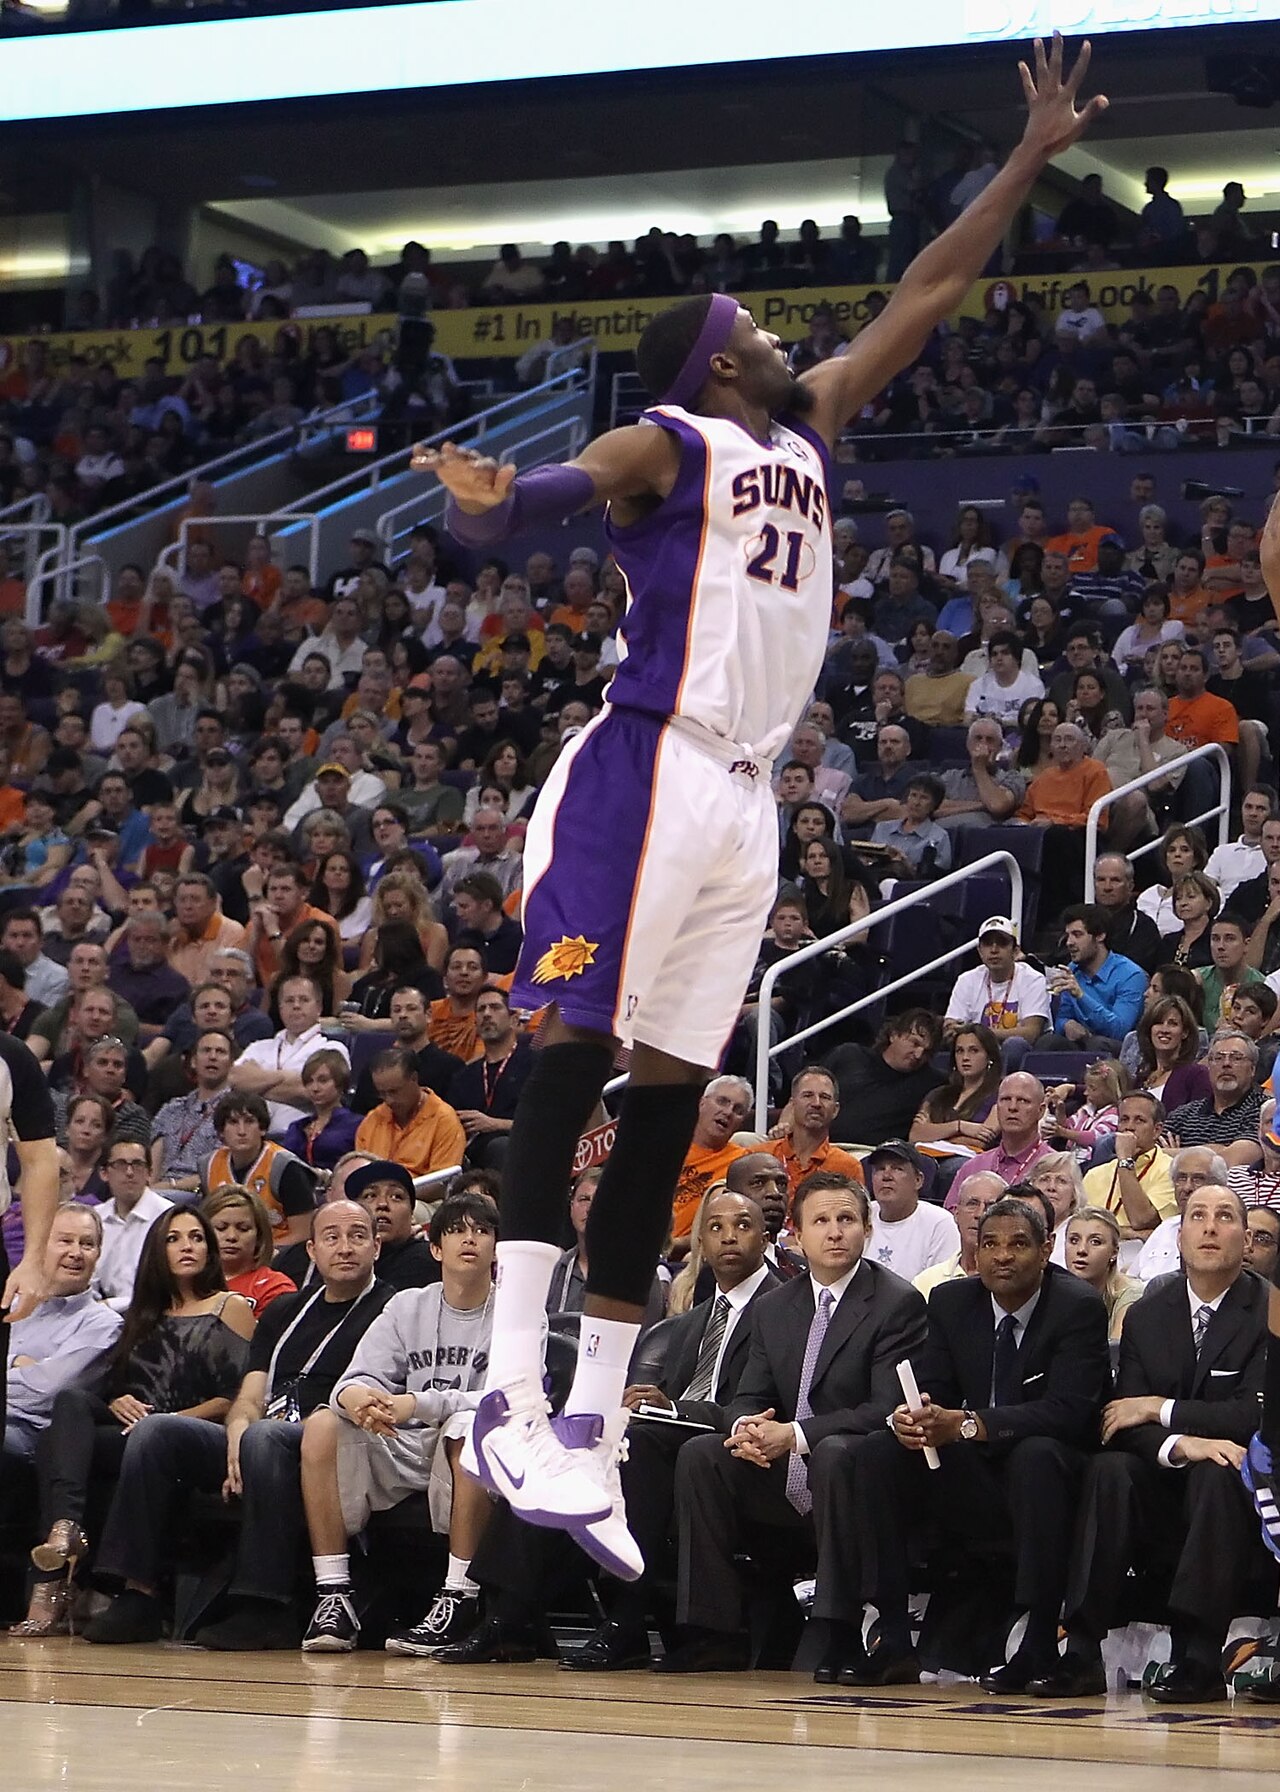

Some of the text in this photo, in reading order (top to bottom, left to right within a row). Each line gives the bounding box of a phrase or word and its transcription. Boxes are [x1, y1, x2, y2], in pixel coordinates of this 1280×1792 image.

[155, 327, 227, 363] 101
[515, 312, 542, 340] In
[731, 464, 827, 534] SUNS
[746, 522, 804, 594] 21
